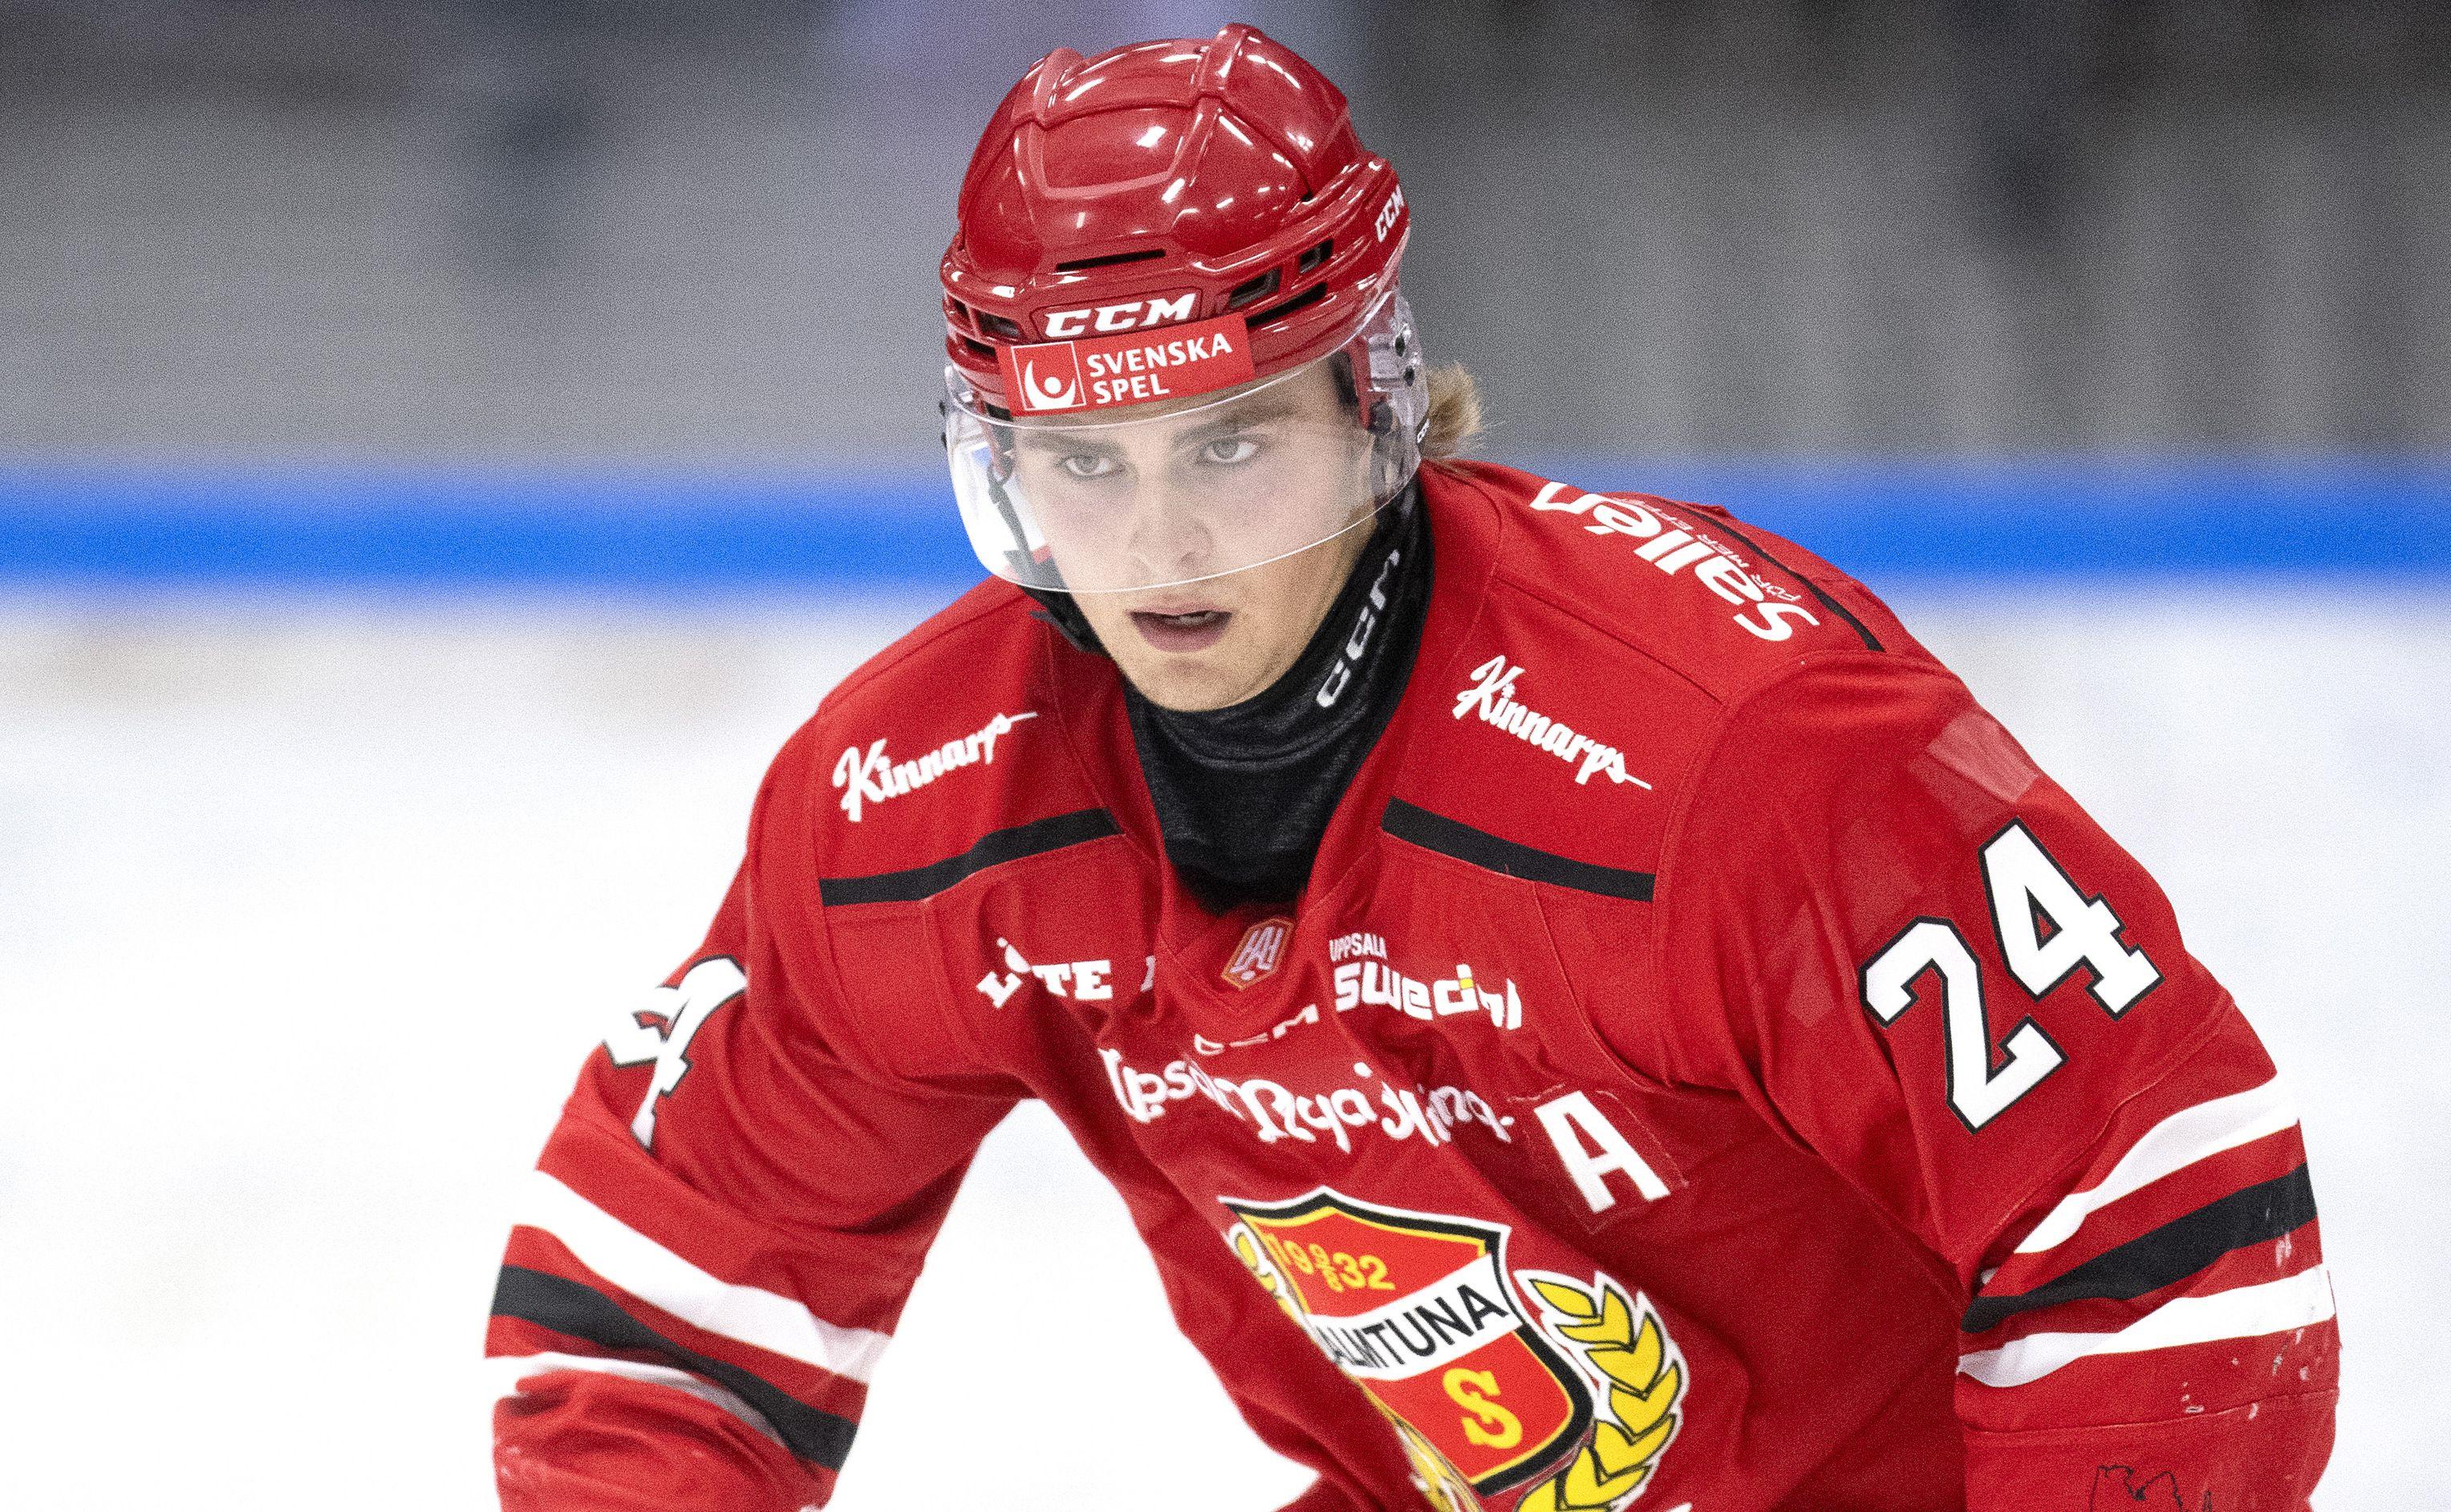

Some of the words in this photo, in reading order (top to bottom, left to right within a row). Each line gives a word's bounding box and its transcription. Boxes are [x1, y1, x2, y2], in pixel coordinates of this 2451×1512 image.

[1374, 184, 1405, 242] CCM
[1044, 294, 1197, 338] CCM
[1086, 333, 1233, 378] SVENSKA
[1094, 375, 1170, 405] SPEL
[1529, 480, 1821, 642] Sallén
[1450, 655, 1653, 790] Kinnarps
[1857, 815, 2166, 1136] 24
[1533, 1090, 1671, 1214] A
[1442, 1368, 1523, 1449] S
